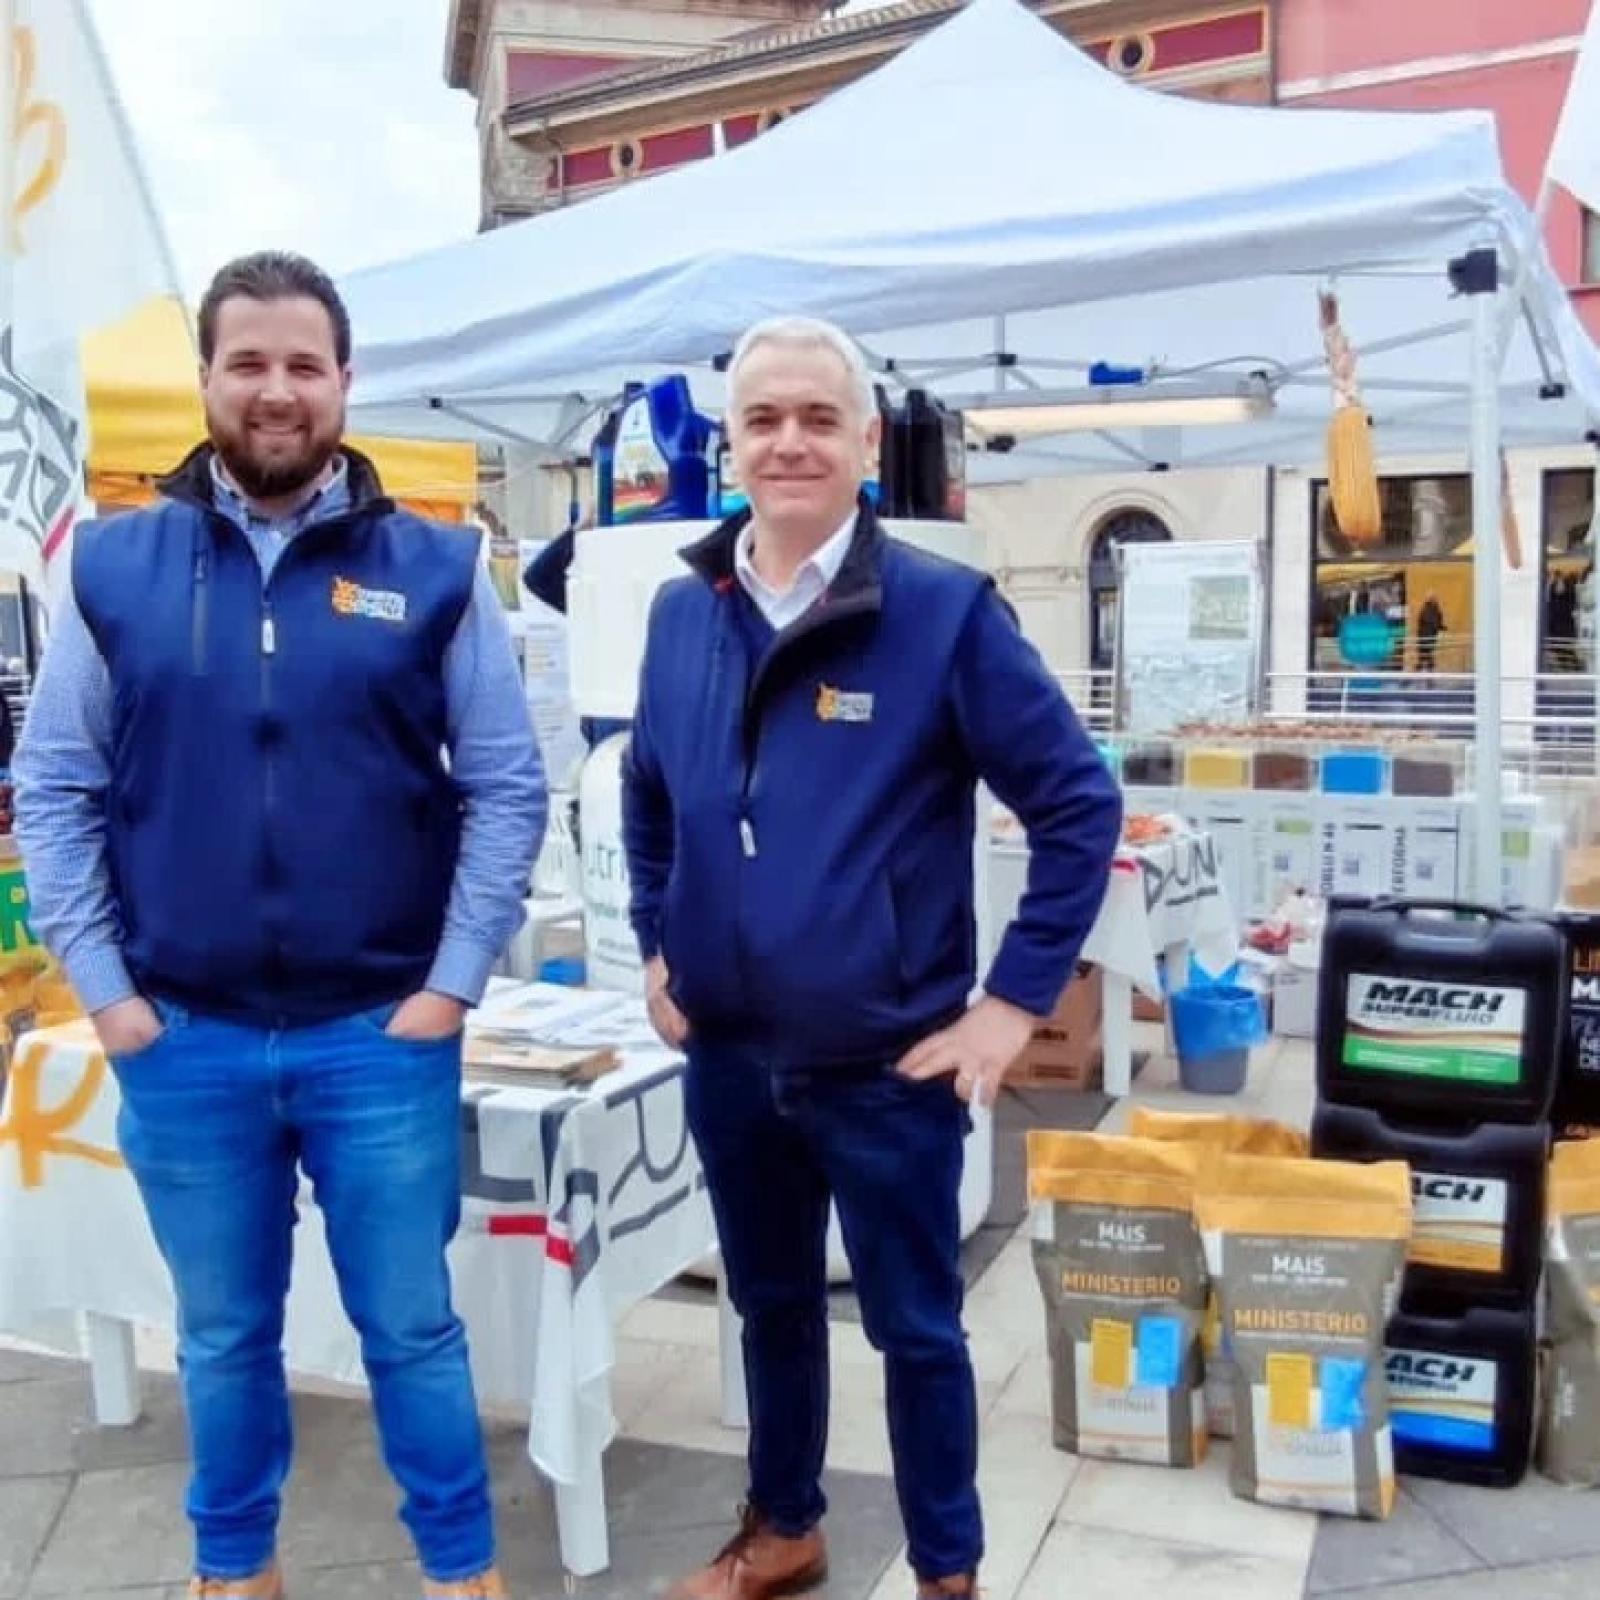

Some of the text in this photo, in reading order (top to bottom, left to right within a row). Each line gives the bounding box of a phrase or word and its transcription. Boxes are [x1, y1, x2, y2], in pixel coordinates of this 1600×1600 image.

[1366, 982, 1506, 1013] MACH
[1098, 1221, 1147, 1242] MAIS
[1271, 1255, 1326, 1276] MAIS
[1061, 1271, 1183, 1295] MINISTERIO
[1233, 1308, 1370, 1334] MINISTERIO
